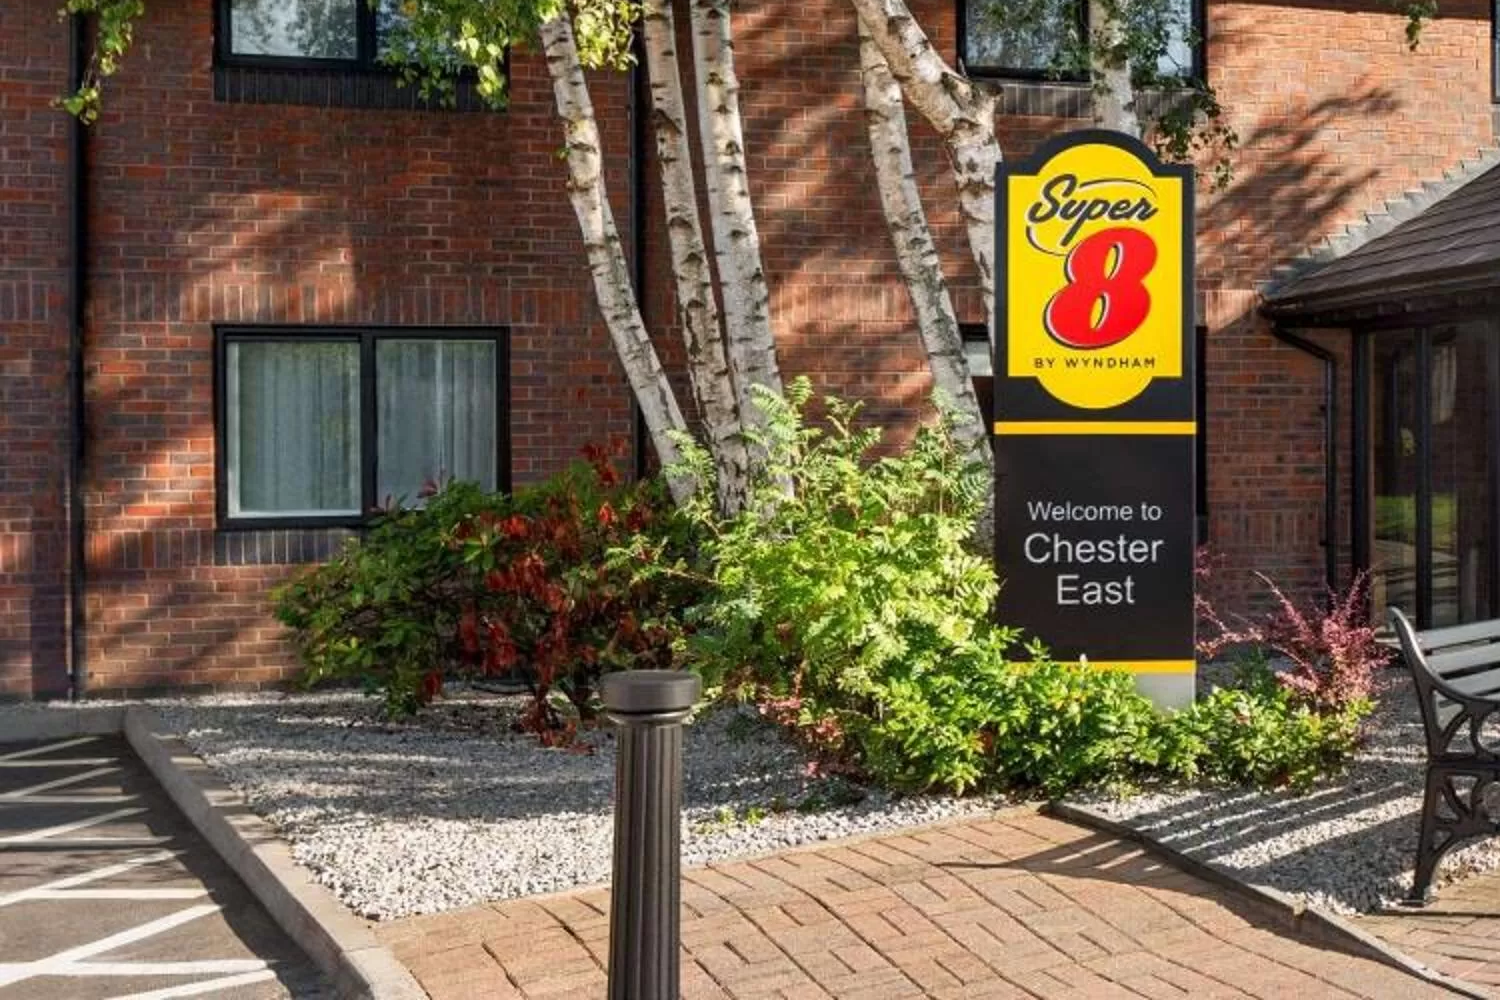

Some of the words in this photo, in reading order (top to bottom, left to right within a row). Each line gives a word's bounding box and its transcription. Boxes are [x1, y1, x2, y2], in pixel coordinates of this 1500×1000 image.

[1027, 174, 1159, 247] Super
[1042, 227, 1159, 349] 8
[1033, 357, 1056, 369] BY
[1064, 356, 1157, 369] WYNDHAM
[1027, 501, 1133, 521] Welcome
[1139, 502, 1162, 521] to
[1023, 532, 1164, 564] Chester
[1056, 574, 1136, 605] East
